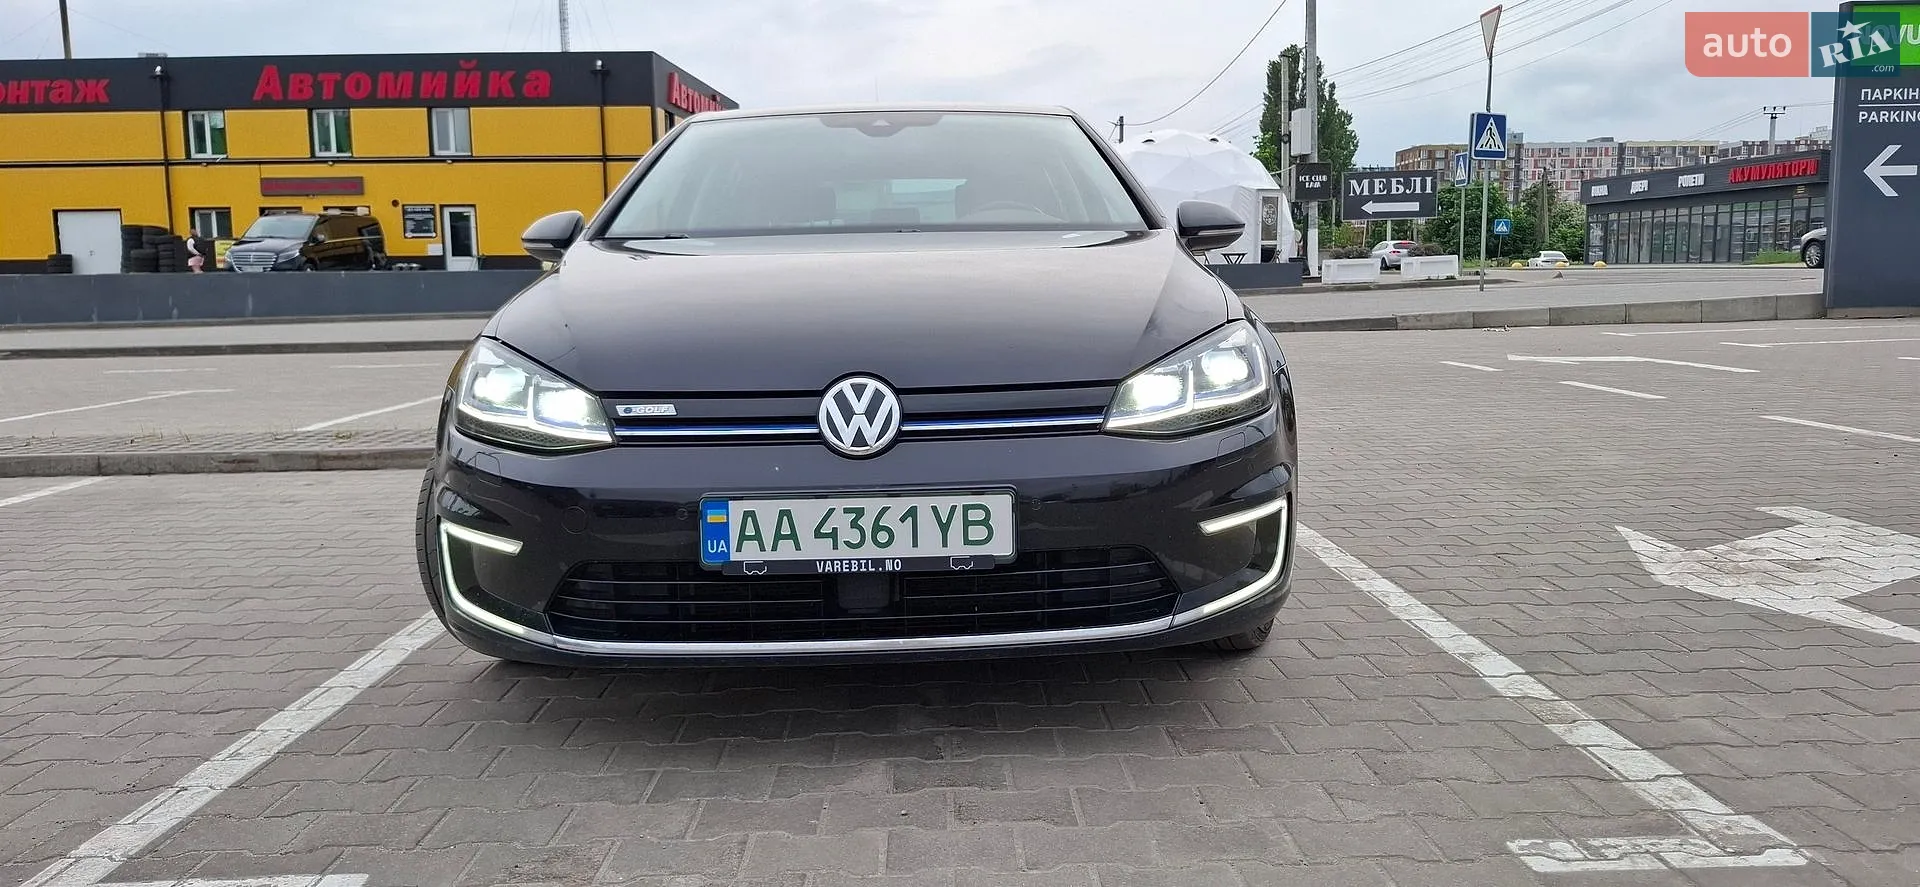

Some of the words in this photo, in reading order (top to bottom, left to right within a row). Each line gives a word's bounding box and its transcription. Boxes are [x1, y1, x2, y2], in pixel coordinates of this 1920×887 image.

[0, 79, 110, 104] нтаж
[253, 59, 552, 100] Автомийка
[1729, 158, 1819, 184] АКУМУЛЯТОРИ
[1348, 176, 1434, 197] МЕБЛІ
[735, 508, 802, 553] AA
[707, 539, 728, 554] UA
[815, 559, 902, 574] VAREBIL.NO
